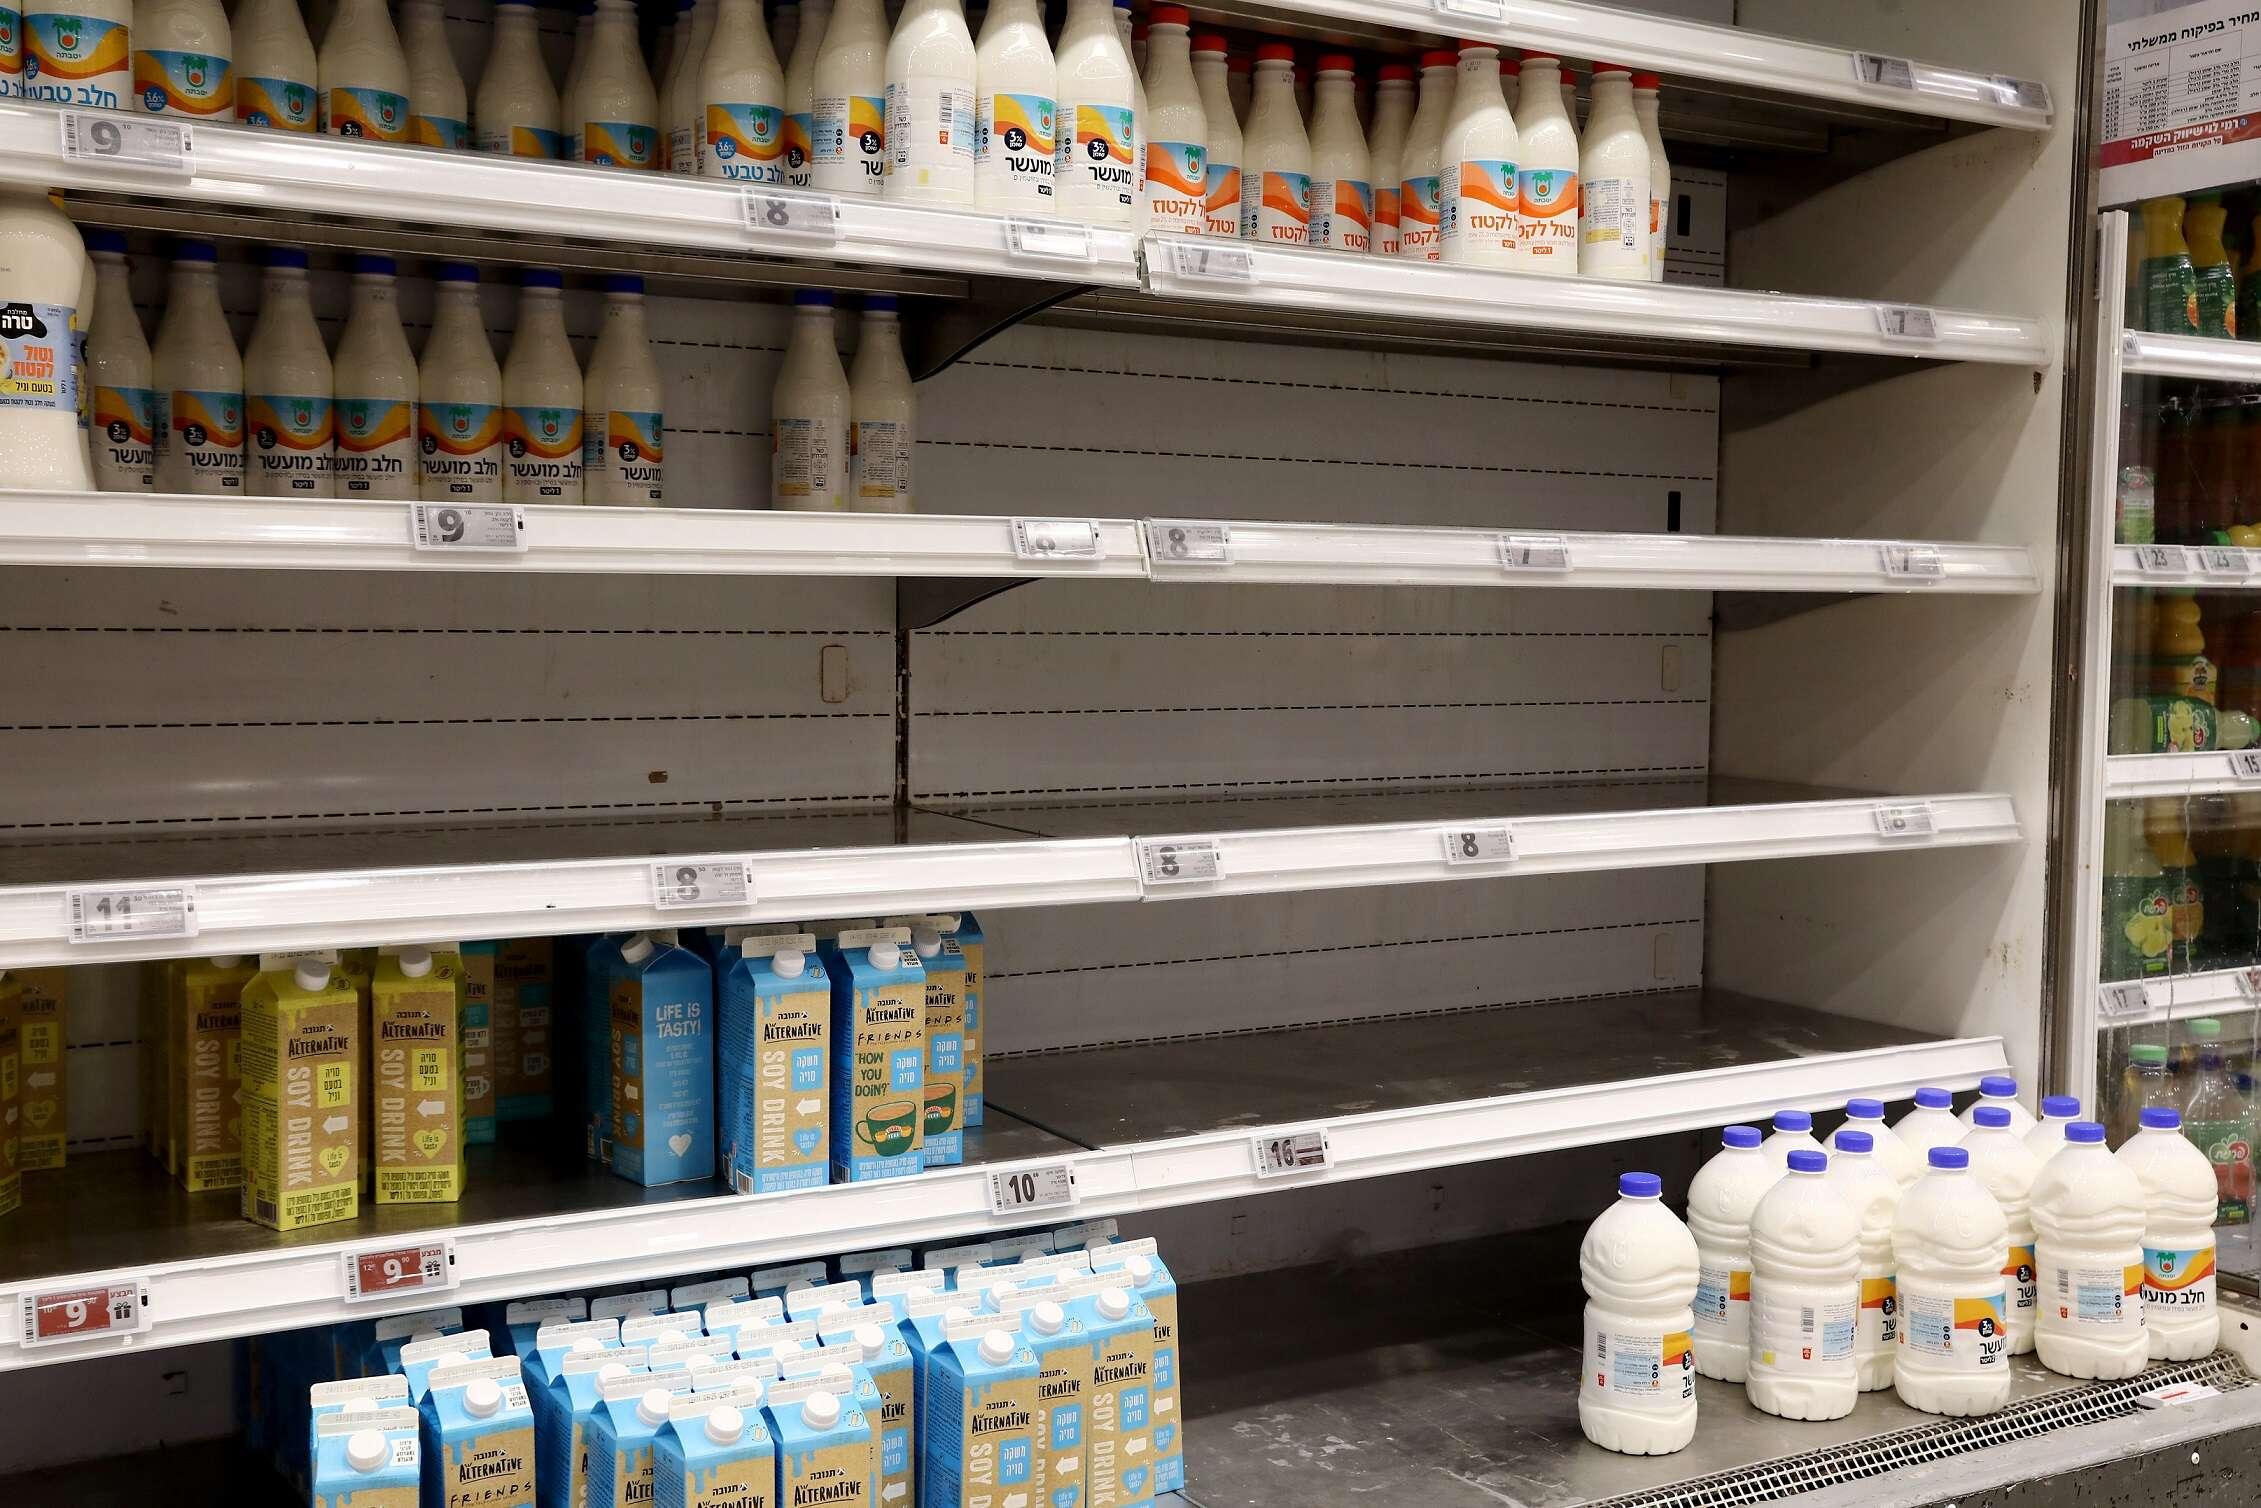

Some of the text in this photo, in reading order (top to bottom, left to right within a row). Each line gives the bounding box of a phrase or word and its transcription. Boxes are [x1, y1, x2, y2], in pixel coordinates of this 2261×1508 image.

[2128, 11, 2260, 51] מחיר בפיקוח ממשלתי
[1869, 57, 1882, 82] 7
[78, 84, 117, 108] חלב
[90, 121, 121, 155] 9
[864, 134, 878, 146] 3%
[1009, 131, 1022, 142] 3%
[1093, 141, 1105, 152] 3%
[722, 163, 764, 180] טבעי
[1005, 156, 1051, 175] מועשר
[1088, 166, 1131, 184] מועשר
[766, 195, 789, 226] 8
[1153, 197, 1197, 216] לקטוז
[1206, 214, 1235, 233] נטול
[1471, 213, 1511, 230] לקטוז
[1550, 219, 1575, 238] נטול
[2, 315, 33, 329] טרה
[1892, 310, 1905, 333] 7
[24, 345, 54, 362] נטול
[13, 361, 54, 378] לקטוז
[16, 382, 53, 393] בטעם וניל
[623, 444, 635, 454] 3%
[185, 452, 237, 467] מועשר
[258, 454, 313, 470] מועשר
[334, 454, 402, 472] חלב מועש
[423, 458, 497, 476] חלב מועשר
[510, 461, 582, 479] חלב מועשר
[619, 467, 662, 482] מועשר
[438, 510, 464, 542] 9
[1169, 528, 1188, 557] 8
[1461, 832, 1479, 858] 8
[1160, 846, 1179, 876] 8
[676, 867, 700, 901] 8
[926, 993, 955, 1005] RNATIVE
[397, 1011, 421, 1019] תנובה
[656, 1002, 701, 1021] LIFE IS
[778, 1012, 800, 1021] תנובה
[866, 1007, 915, 1025] ALTERNATIVE
[926, 1015, 962, 1025] ENDS
[303, 1026, 325, 1035] תנובה
[382, 1021, 446, 1040] ALTERNATIVE
[656, 1020, 702, 1038] TASTY!
[764, 1022, 822, 1042] ALTERNATIVE
[858, 1029, 922, 1046] FRIENDS
[288, 1036, 349, 1058] ALTERNATIVE
[936, 1040, 957, 1053] משקה
[796, 1055, 818, 1068] משקה
[896, 1056, 917, 1069] משקה
[799, 1071, 816, 1083] סויה
[861, 1069, 881, 1081] YOU
[196, 1040, 221, 1151] SOY DRINK
[381, 1049, 406, 1162] SOY DRINK
[763, 1050, 785, 1163] SOY DRINK
[288, 1066, 312, 1186] SOY DRINK
[1271, 1139, 1295, 1168] 16
[1009, 1174, 1035, 1203] 10
[421, 1249, 442, 1258] מבצע
[383, 1259, 402, 1285] 9
[2181, 1289, 2205, 1304] חלב
[65, 1301, 87, 1328] 9
[1982, 1320, 1992, 1330] 3%
[1980, 1338, 2002, 1354] עשר
[1107, 1353, 1127, 1362] תנובה
[1154, 1355, 1169, 1370] משק
[1040, 1371, 1060, 1379] תנובה
[1094, 1361, 1147, 1385] ALTERNATIVE
[1039, 1379, 1081, 1398] TERNATIVE
[986, 1402, 1008, 1410] תנובה
[1124, 1393, 1144, 1409] משקה
[972, 1411, 1030, 1435] ALTERNATIVE
[1056, 1411, 1077, 1426] משקה
[1127, 1409, 1142, 1423] סויה
[1059, 1428, 1075, 1441] סויה
[474, 1450, 498, 1462] תנובה
[1003, 1445, 1026, 1460] משקה
[1093, 1392, 1115, 1506] SOY DRINK
[884, 1454, 901, 1468] סויה
[970, 1443, 992, 1485] SOY
[459, 1458, 523, 1482] ALTERNATIVE
[810, 1470, 836, 1481] תנובה
[1006, 1463, 1023, 1477] סויה
[450, 1482, 532, 1505] FRIENDS
[712, 1486, 738, 1496] תנובה
[795, 1481, 862, 1507] ALTERNATIVE
